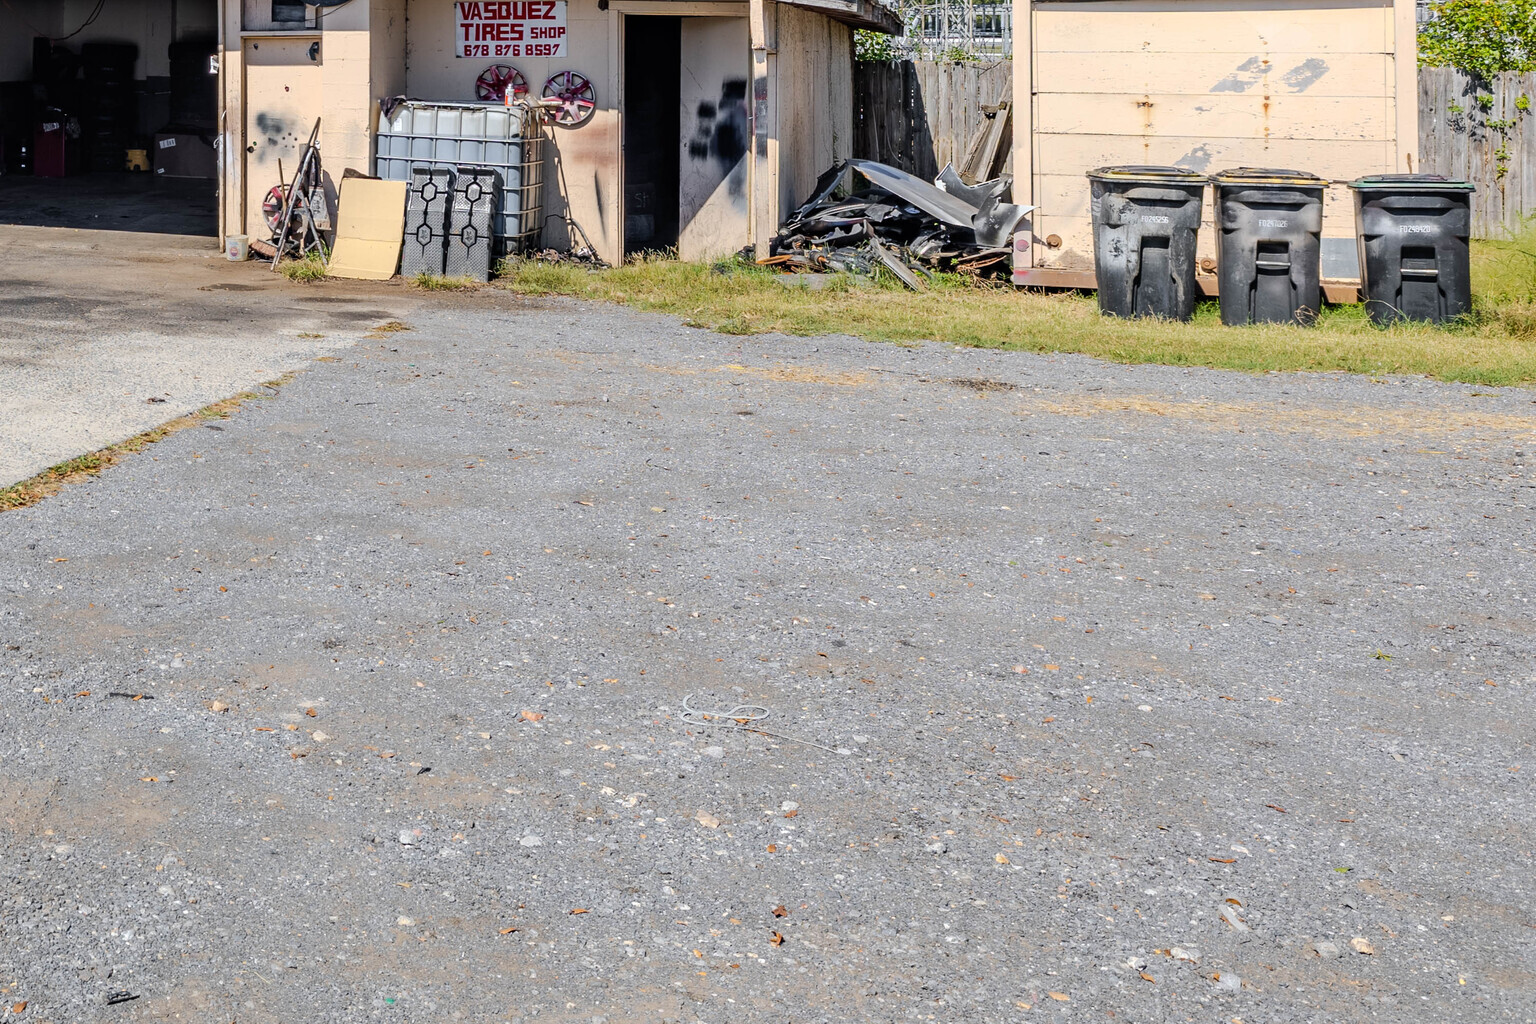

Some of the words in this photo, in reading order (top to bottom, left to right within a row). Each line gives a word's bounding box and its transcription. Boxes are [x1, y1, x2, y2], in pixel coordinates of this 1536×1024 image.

[459, 1, 557, 21] VASQUEZ
[460, 23, 524, 42] TIRES
[530, 27, 566, 39] SHOP
[464, 44, 490, 57] 678
[495, 44, 521, 57] 876
[525, 44, 561, 57] 8597
